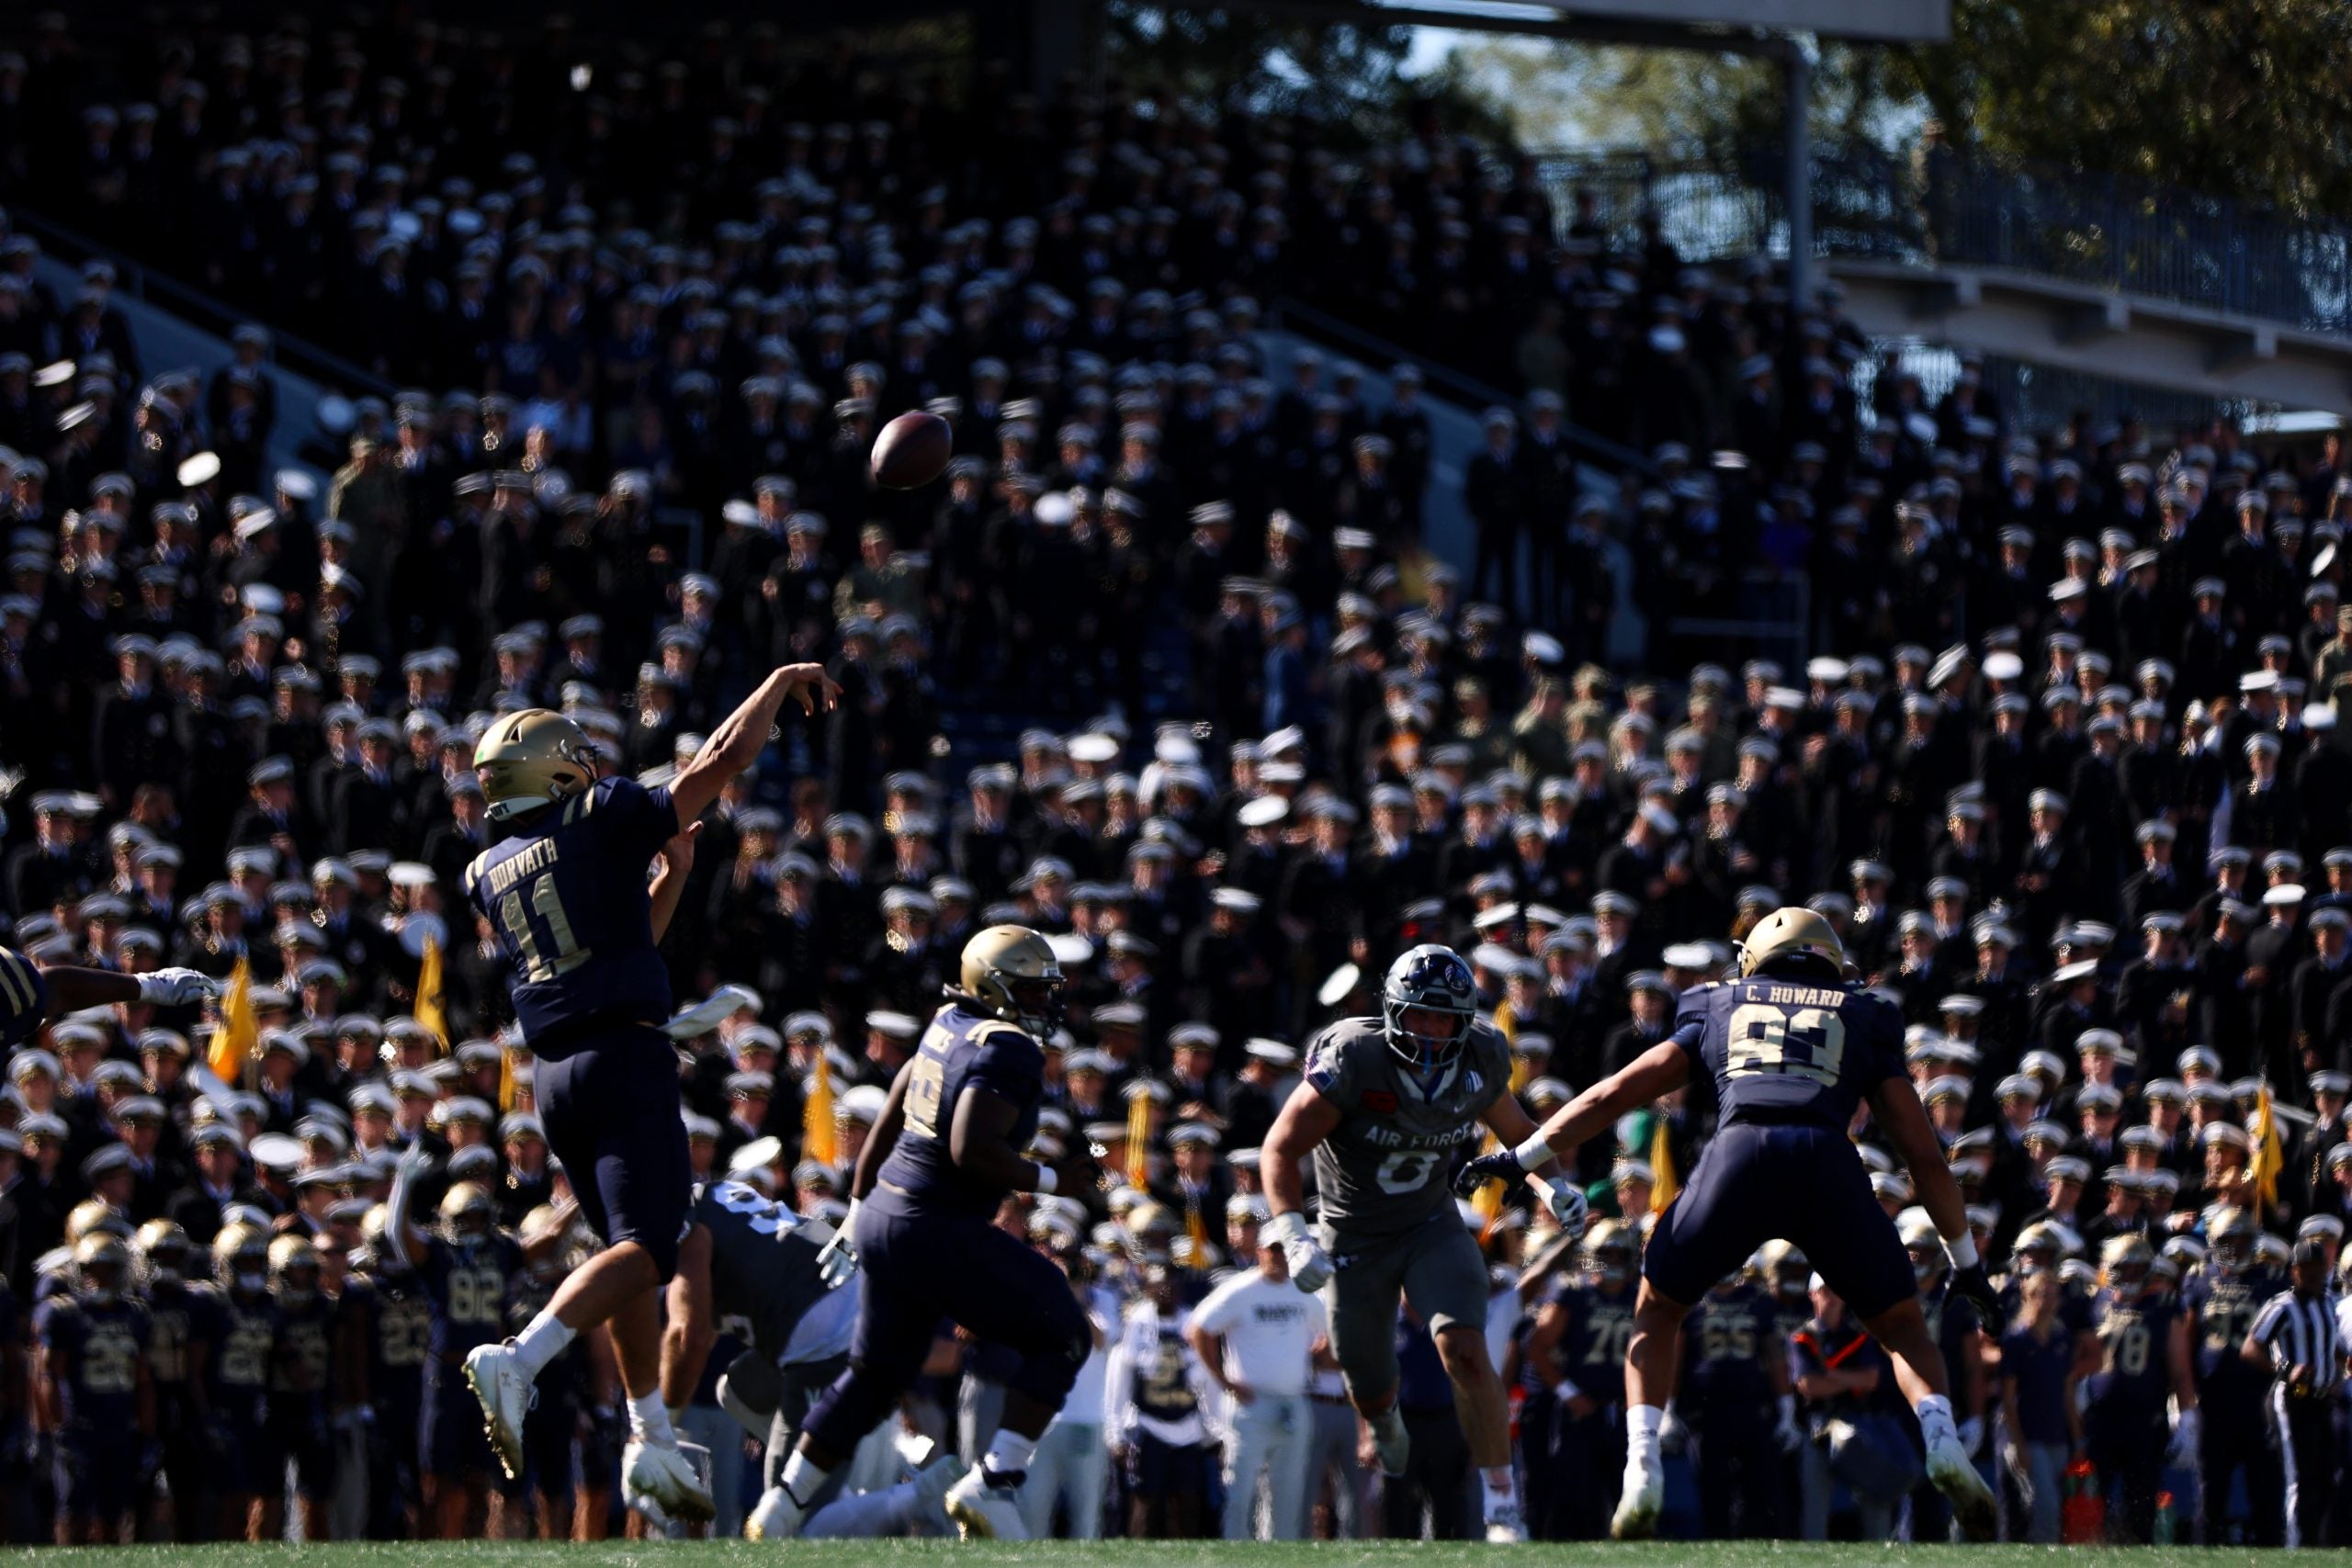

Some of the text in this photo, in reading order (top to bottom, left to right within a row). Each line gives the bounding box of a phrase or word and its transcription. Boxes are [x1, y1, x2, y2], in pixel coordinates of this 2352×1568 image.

[488, 836, 559, 895] HORVATH
[503, 873, 593, 984] 11
[1746, 985, 1846, 1008] C. HOWARD
[1364, 1124, 1402, 1146] AIR
[447, 1267, 504, 1325] 82
